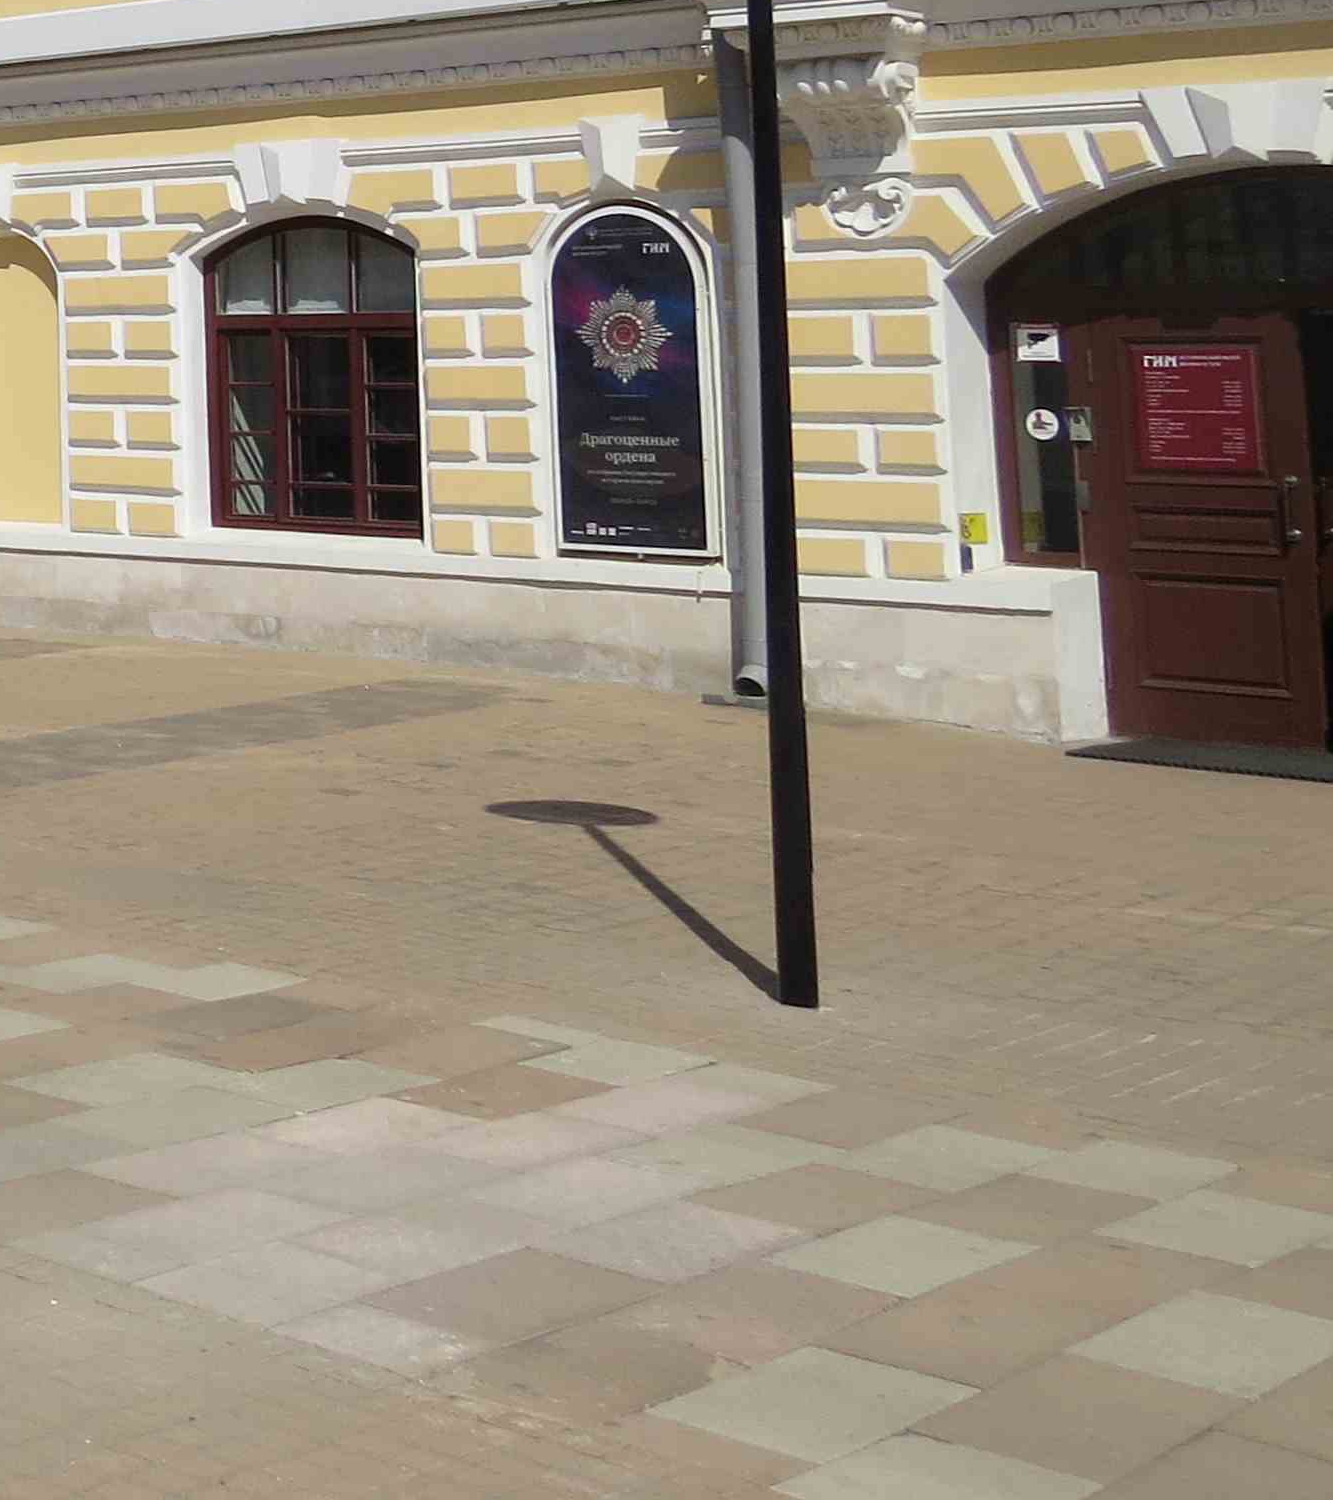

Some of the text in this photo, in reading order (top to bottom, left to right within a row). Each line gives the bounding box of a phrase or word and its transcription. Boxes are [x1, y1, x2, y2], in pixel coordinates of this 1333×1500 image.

[642, 242, 670, 254] ГИМ
[1143, 355, 1178, 368] ГИМ
[580, 432, 680, 448] Драгоценные
[604, 451, 657, 465] ордена
